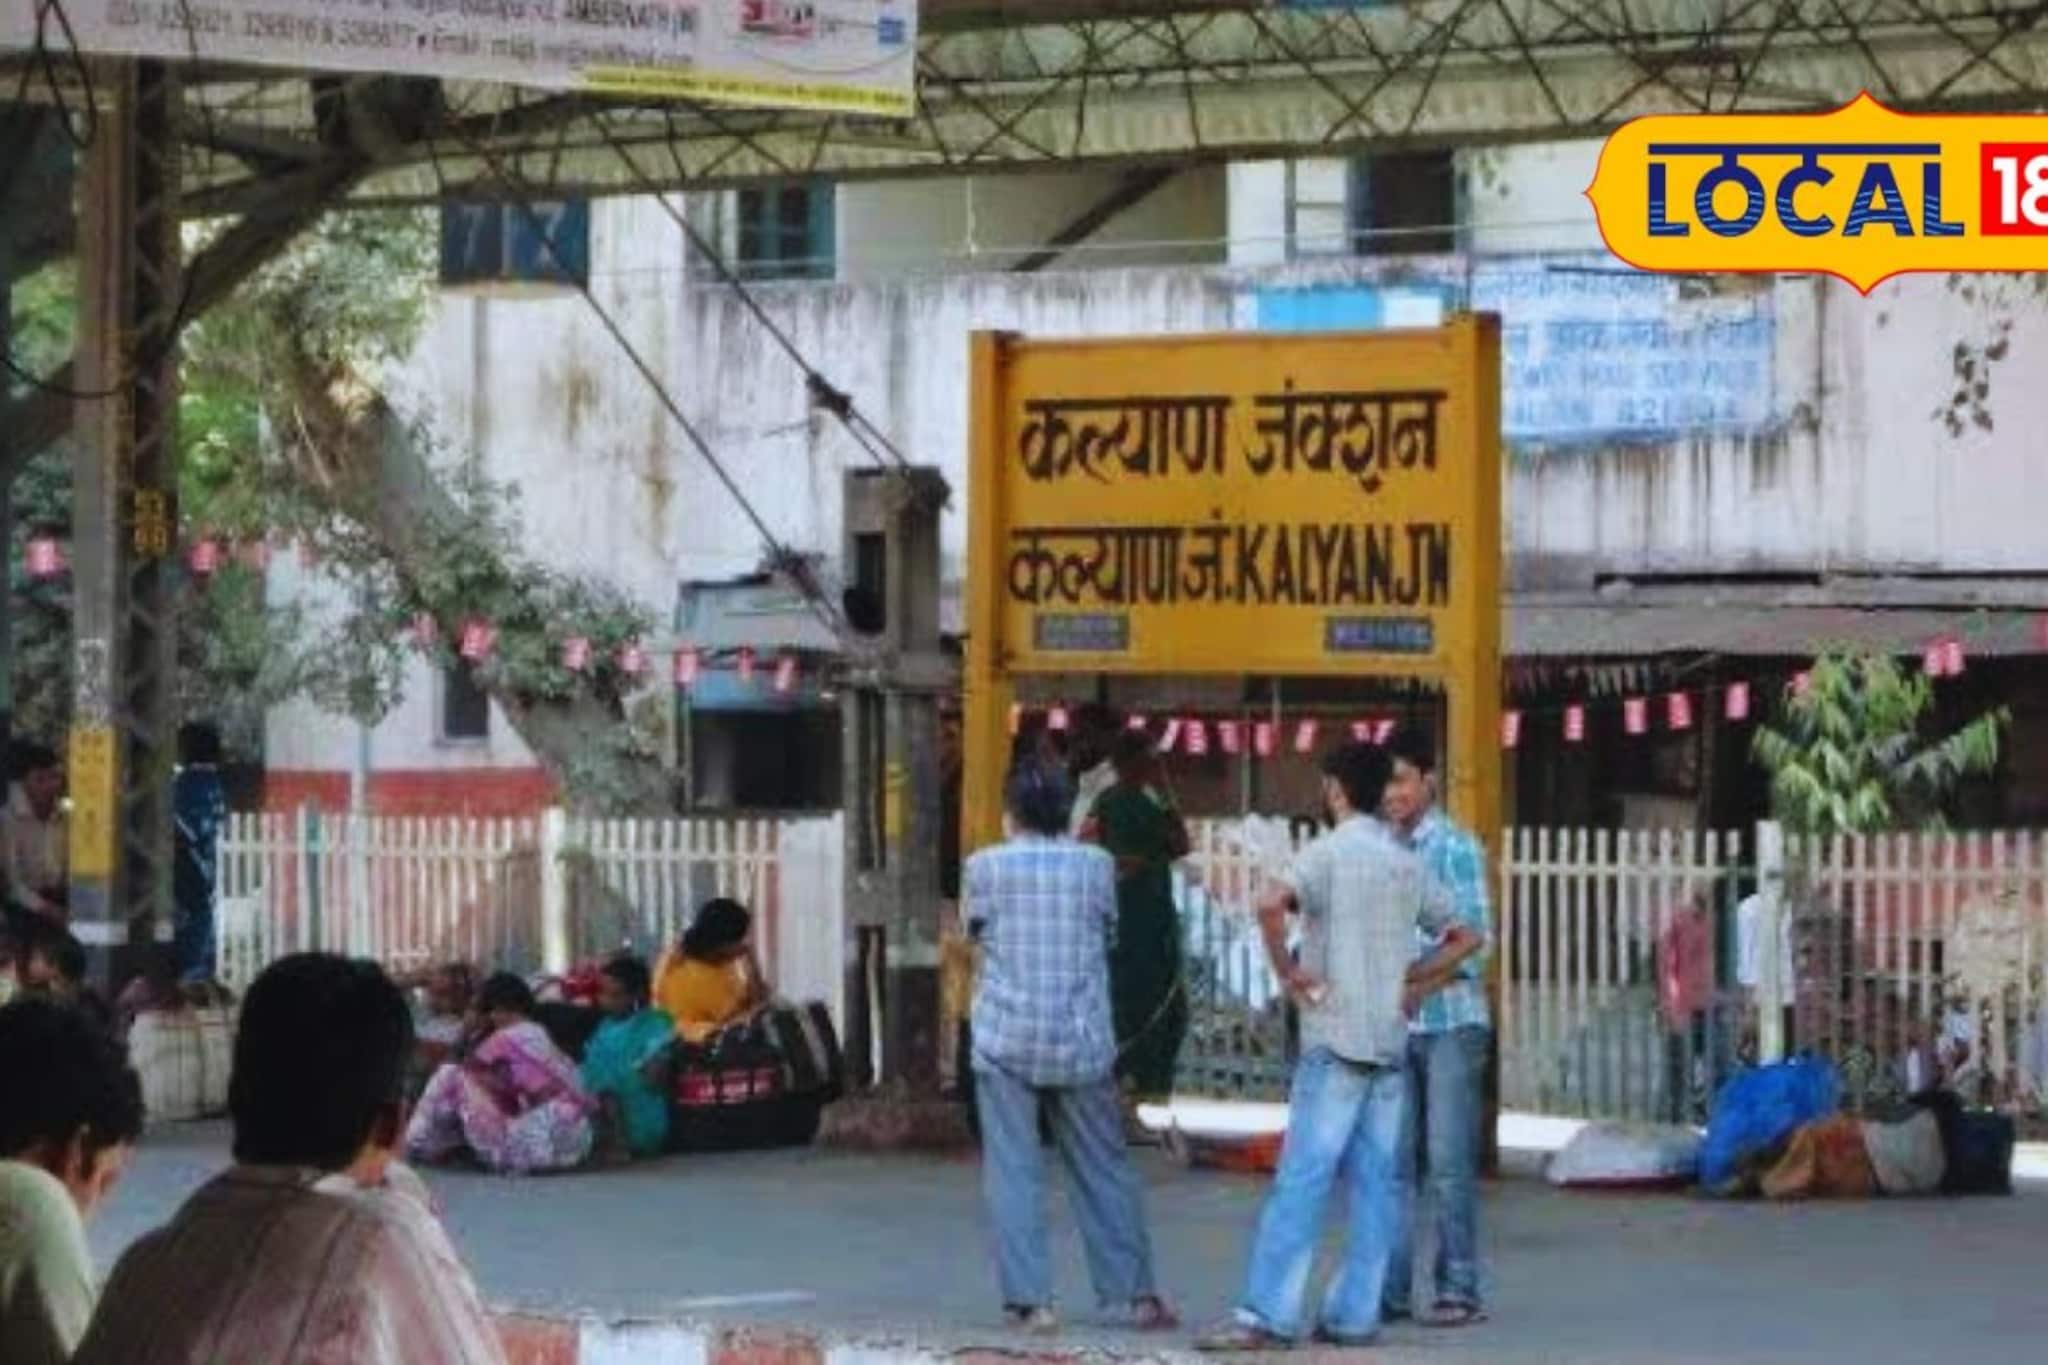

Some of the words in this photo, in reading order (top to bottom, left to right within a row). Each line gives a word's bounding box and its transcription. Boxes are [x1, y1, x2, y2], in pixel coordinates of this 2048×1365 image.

[1019, 395, 1232, 484] कल्याण
[1245, 377, 1448, 494] जंक्शन
[1007, 525, 1184, 605] कल्याण
